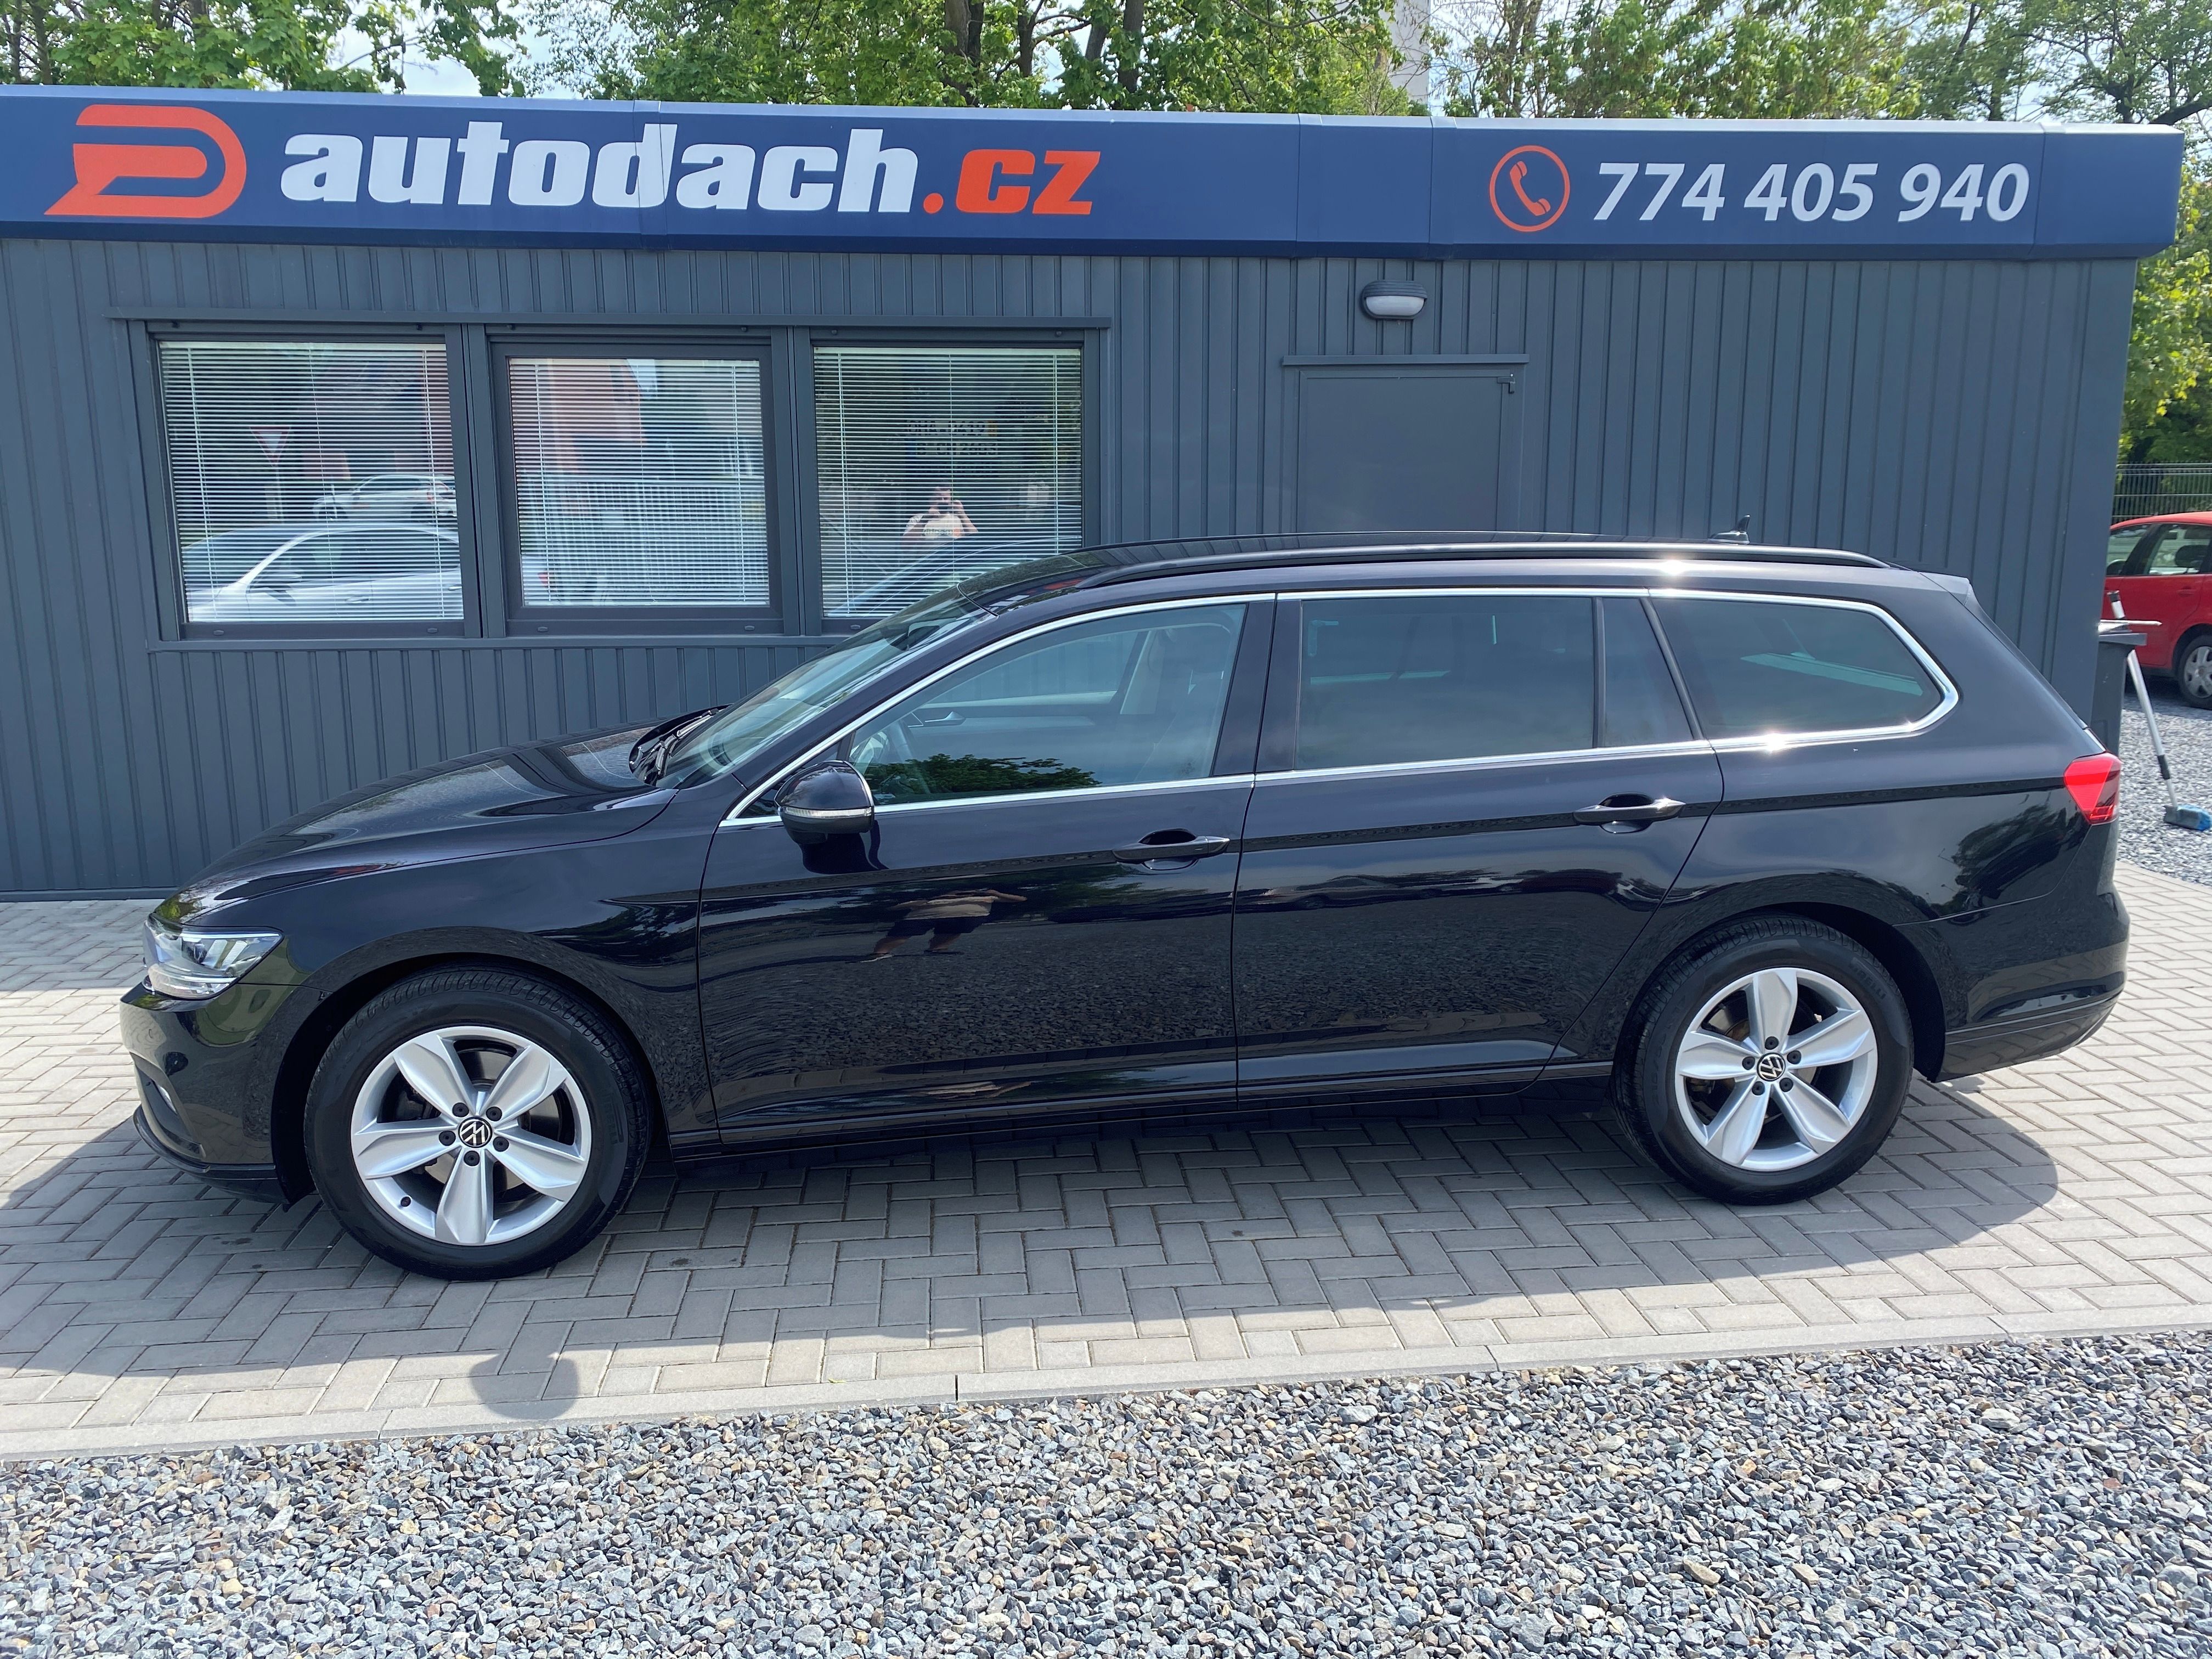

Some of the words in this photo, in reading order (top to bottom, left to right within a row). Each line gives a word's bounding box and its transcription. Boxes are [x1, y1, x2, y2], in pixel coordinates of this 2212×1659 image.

[280, 121, 1101, 215] autodach.cz
[1593, 162, 1726, 221] 774
[1743, 163, 1878, 222] 405
[1898, 163, 2029, 222] 940
